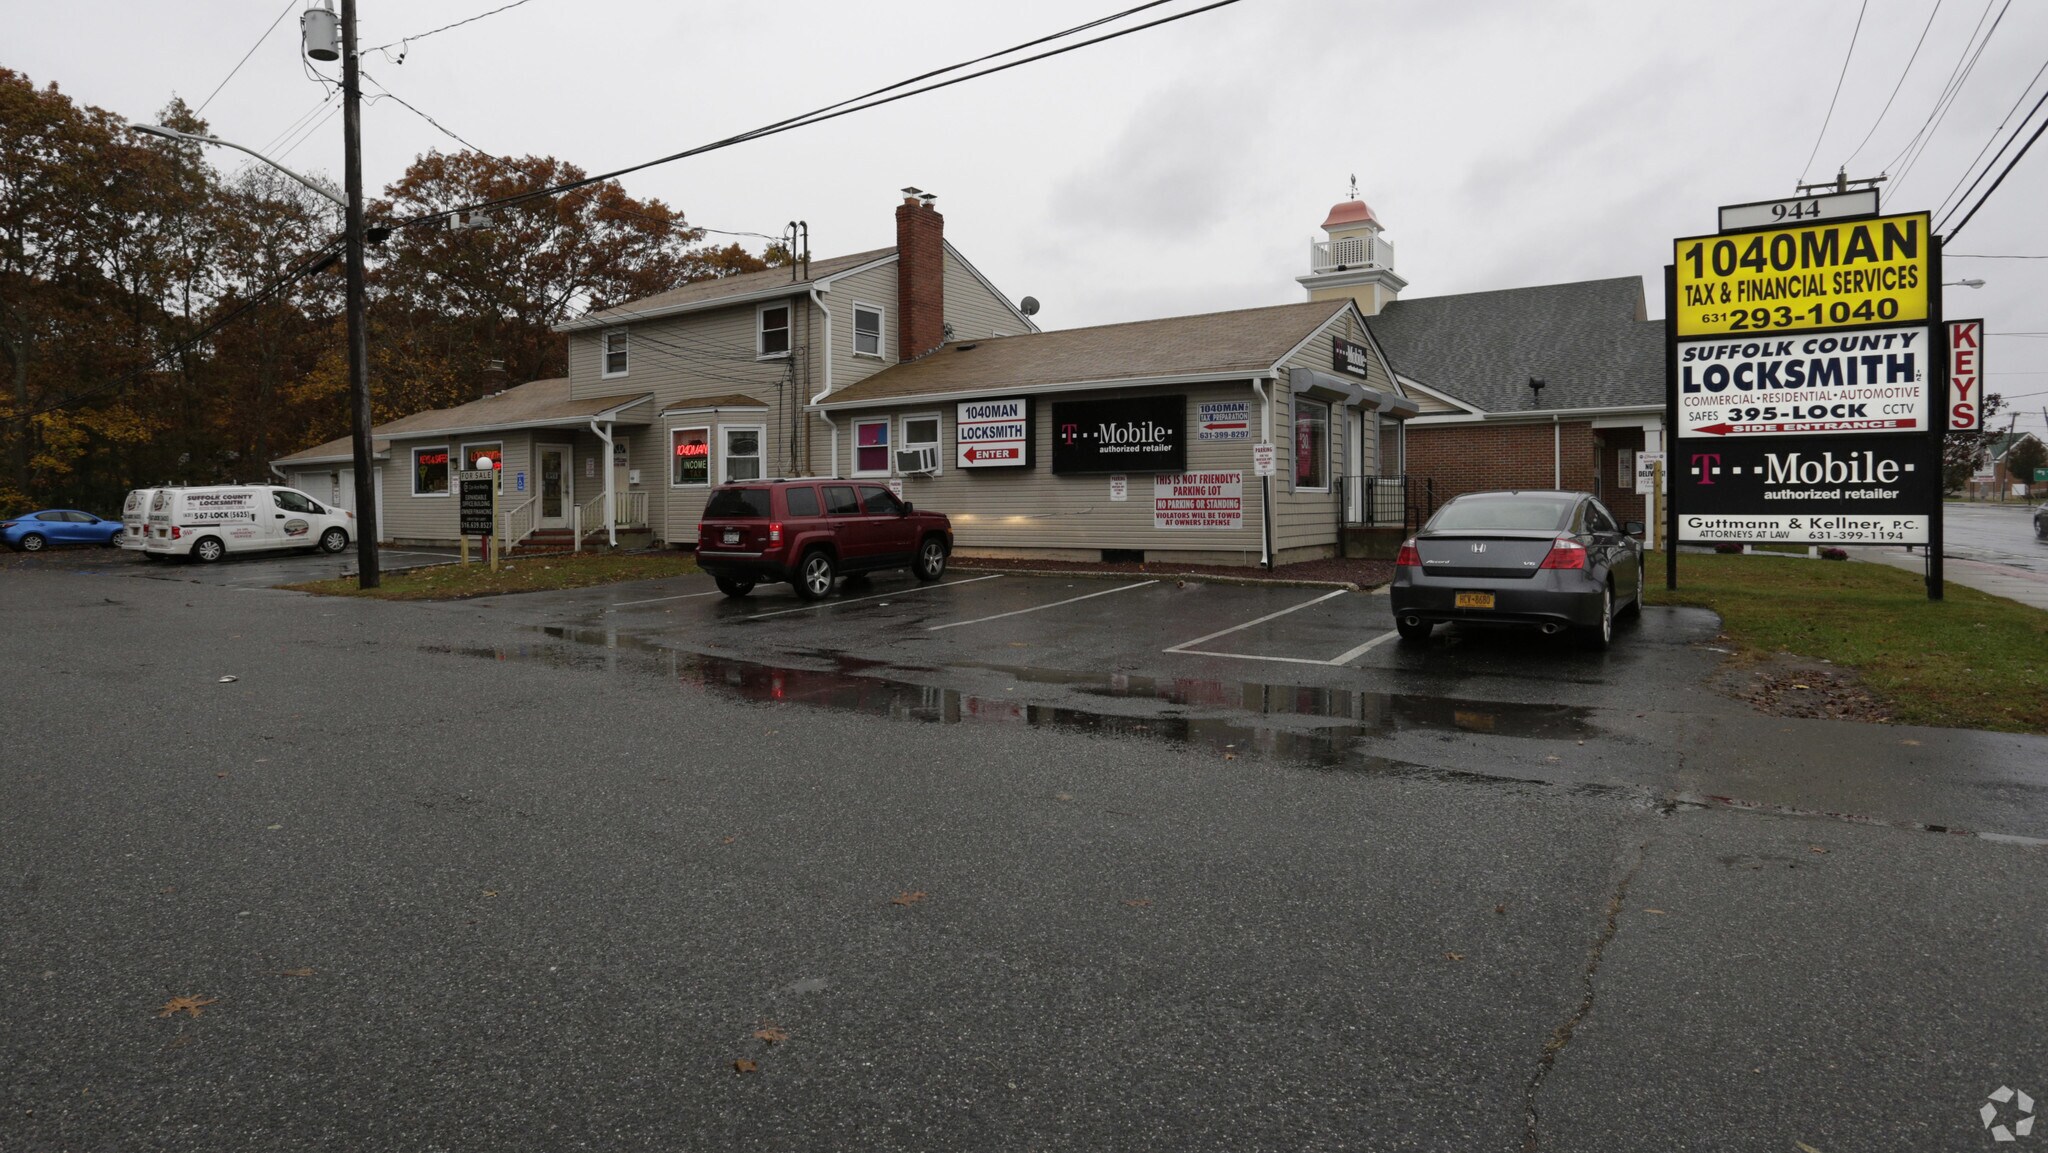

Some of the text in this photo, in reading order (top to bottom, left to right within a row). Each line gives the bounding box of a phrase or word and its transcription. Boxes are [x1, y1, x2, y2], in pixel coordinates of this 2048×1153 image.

[1772, 200, 1820, 222] 944
[1685, 220, 1918, 279] 1040MAN
[1685, 264, 1918, 306] TAX & FINANCIAL SERVICES
[1702, 297, 1899, 330] 631 293-1040
[1682, 332, 1920, 362] SUFFOLK COUNTY
[1682, 352, 1915, 394] LOCKSMITH
[1951, 323, 1978, 428] KEYS
[1684, 386, 1920, 407] COMMERCIAL RESIDENTIAL AUTOMOTIVE
[965, 404, 1018, 420] 1040MAN
[1200, 404, 1244, 413] 1040MAN
[1689, 403, 1915, 422] SAFES 395-LOCK CCTV
[1212, 412, 1248, 421] PREPARATION
[961, 424, 1022, 440] LOCKSMITH
[1732, 420, 1897, 432] SIDE ENTRANCE
[1200, 431, 1249, 439] 631-399-8297
[976, 450, 1010, 460] ENTER
[1100, 444, 1172, 454] authorized retailer
[684, 461, 706, 469] INCOME
[1764, 450, 1900, 484] Mobile
[1156, 473, 1241, 485] THIS IS NOT FRIENDLY'S
[1173, 486, 1222, 496] PARKING LOT
[1764, 488, 1900, 500] authorized retailer
[1158, 499, 1239, 509] NO PARKING OR STANDING
[1688, 517, 1919, 531] Guttmann & Kellner, P.C.
[1699, 530, 1904, 540] ATTORNEYS AT LAW 631-399-1194
